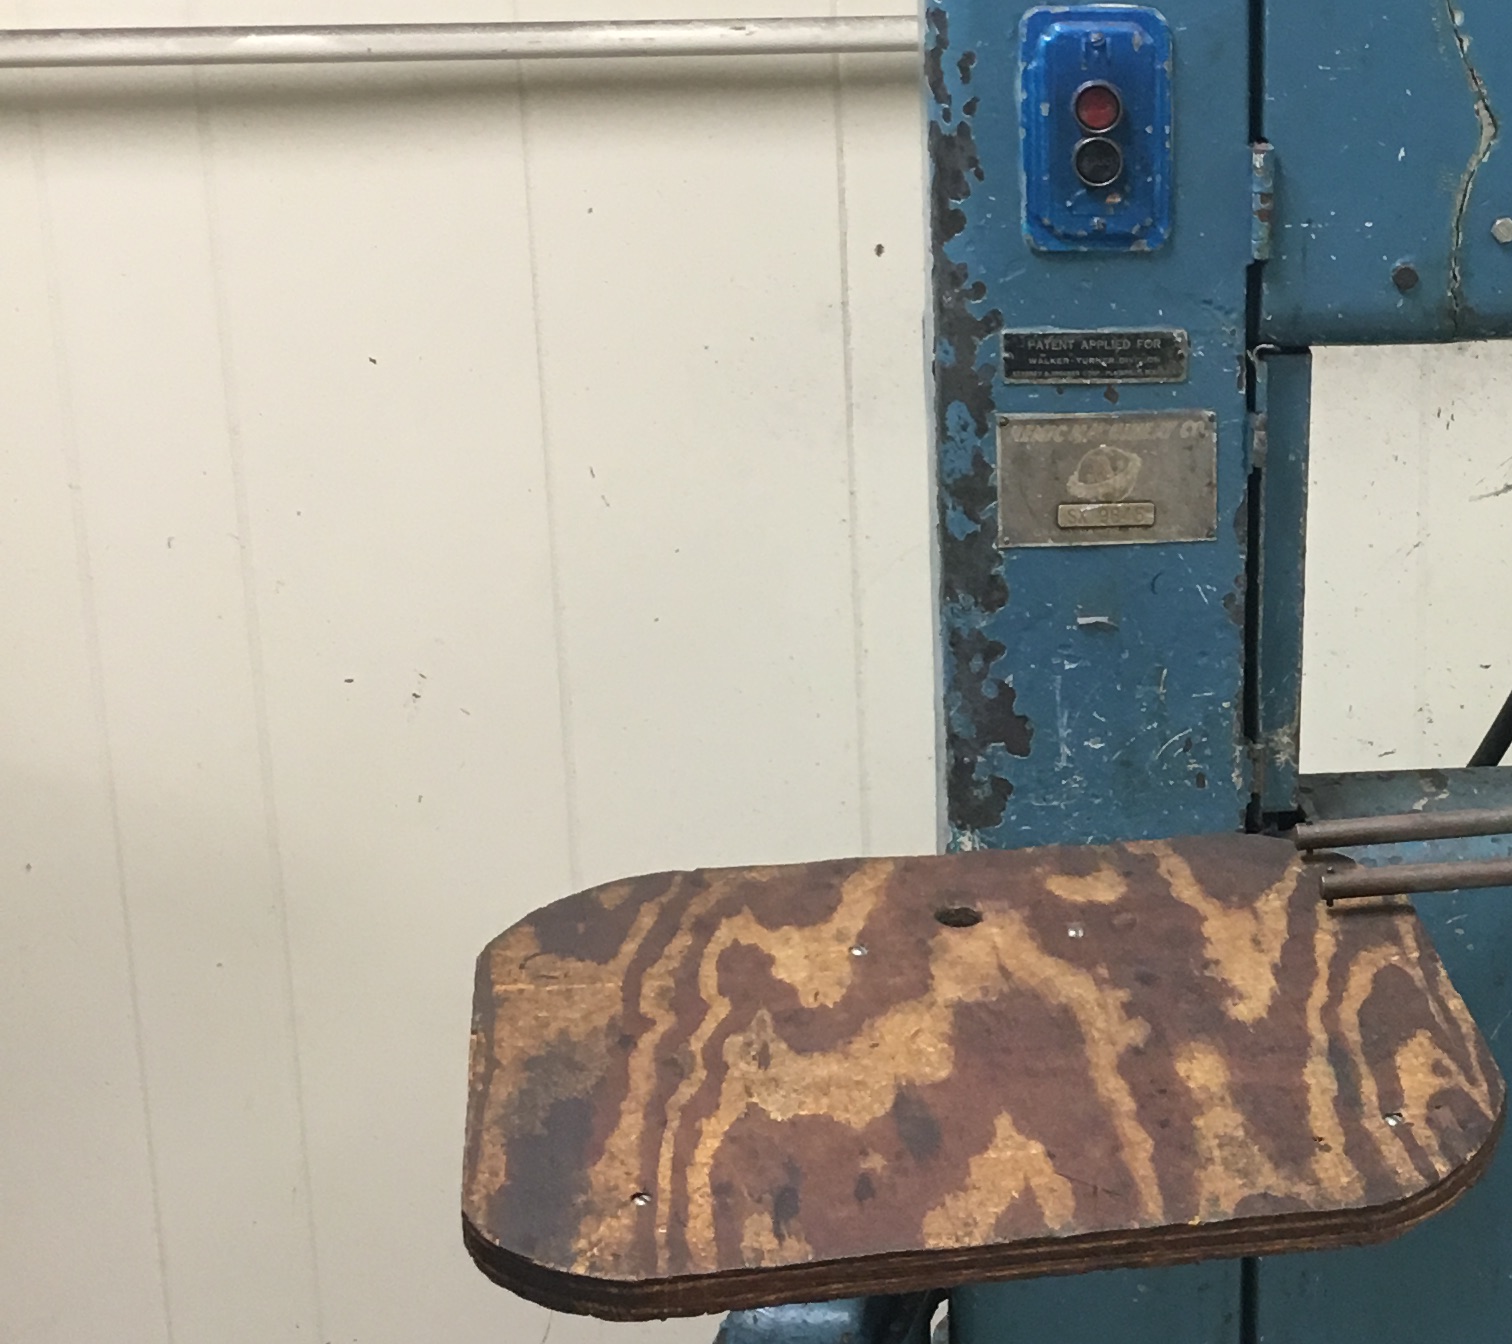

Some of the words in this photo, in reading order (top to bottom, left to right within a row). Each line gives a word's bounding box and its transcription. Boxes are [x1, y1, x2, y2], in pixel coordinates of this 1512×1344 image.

[1028, 340, 1075, 350] PATENT
[1081, 339, 1131, 350] APPLIED
[1137, 339, 1161, 349] FOR
